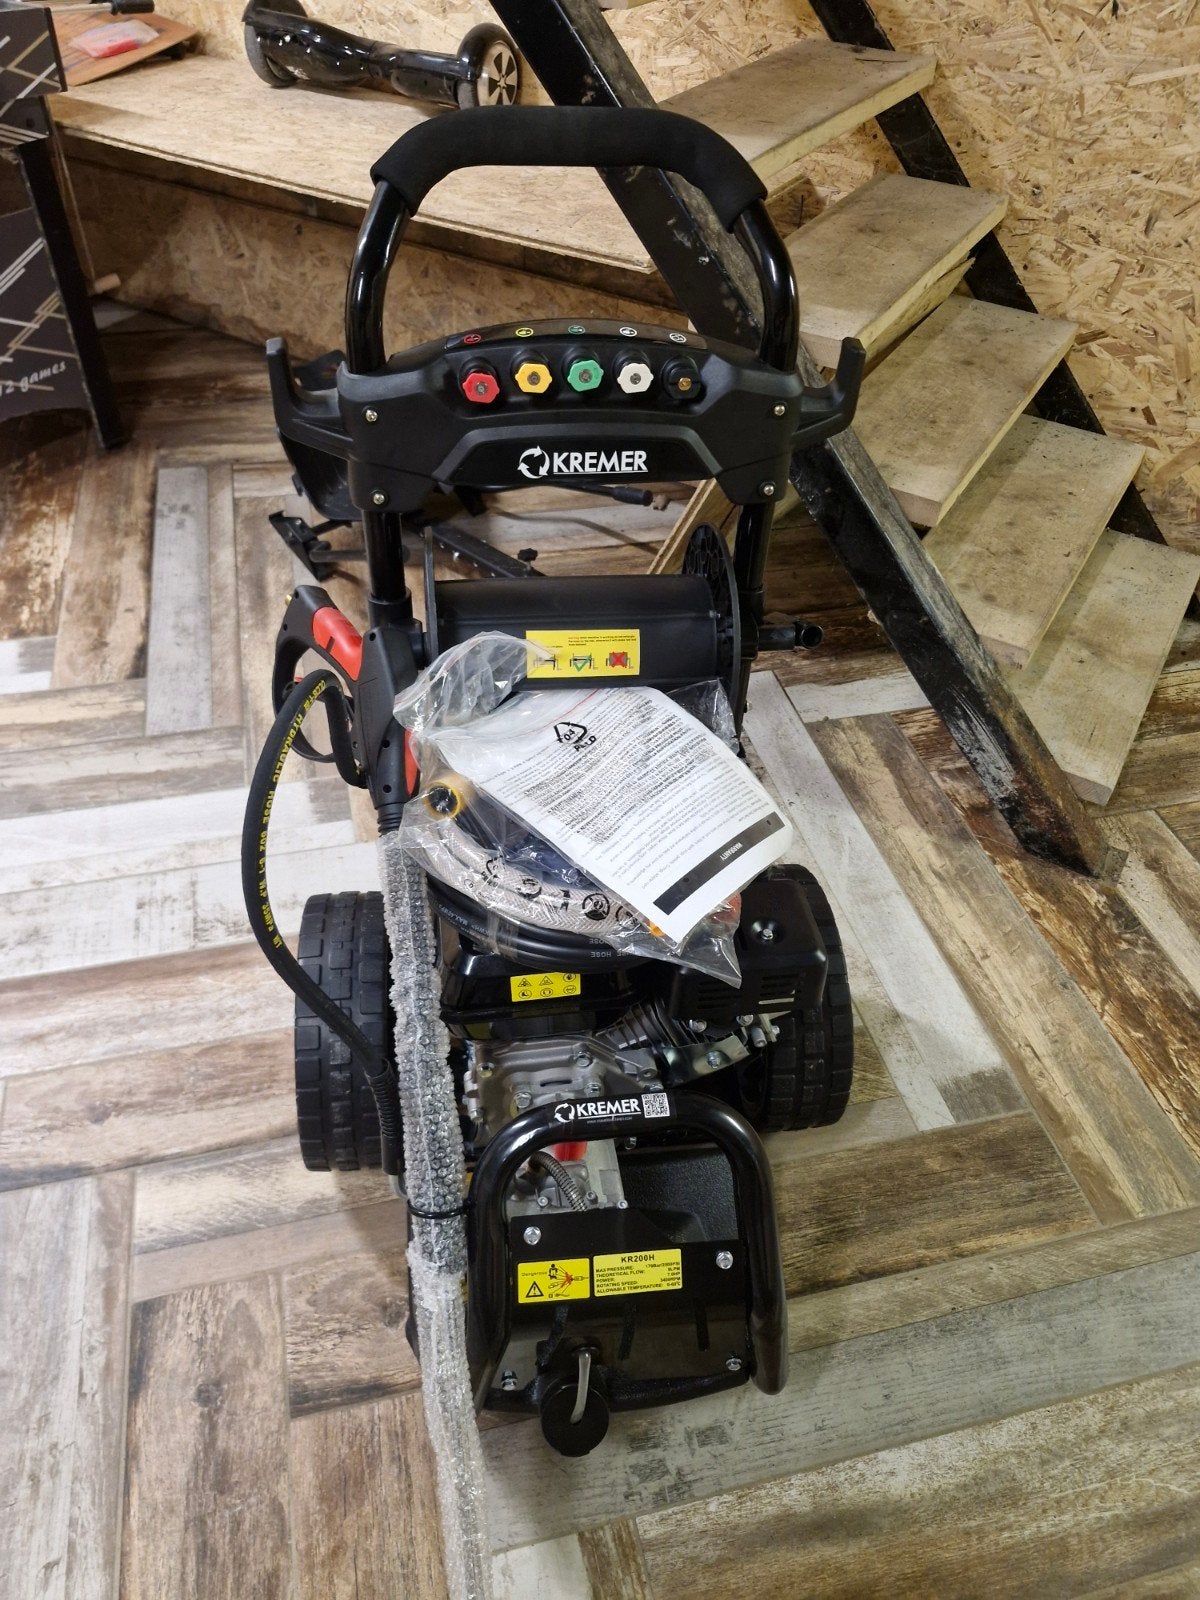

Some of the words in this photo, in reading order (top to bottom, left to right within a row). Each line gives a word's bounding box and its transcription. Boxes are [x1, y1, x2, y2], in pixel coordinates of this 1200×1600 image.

[20, 361, 66, 393] games
[553, 450, 648, 473] KREMER
[563, 728, 576, 741] 04
[273, 713, 303, 783] HYDRAULIC
[262, 790, 276, 824] HOSE
[720, 842, 743, 861] WARRANTY
[576, 1098, 641, 1117] KREMER
[621, 1253, 655, 1264] KR200H
